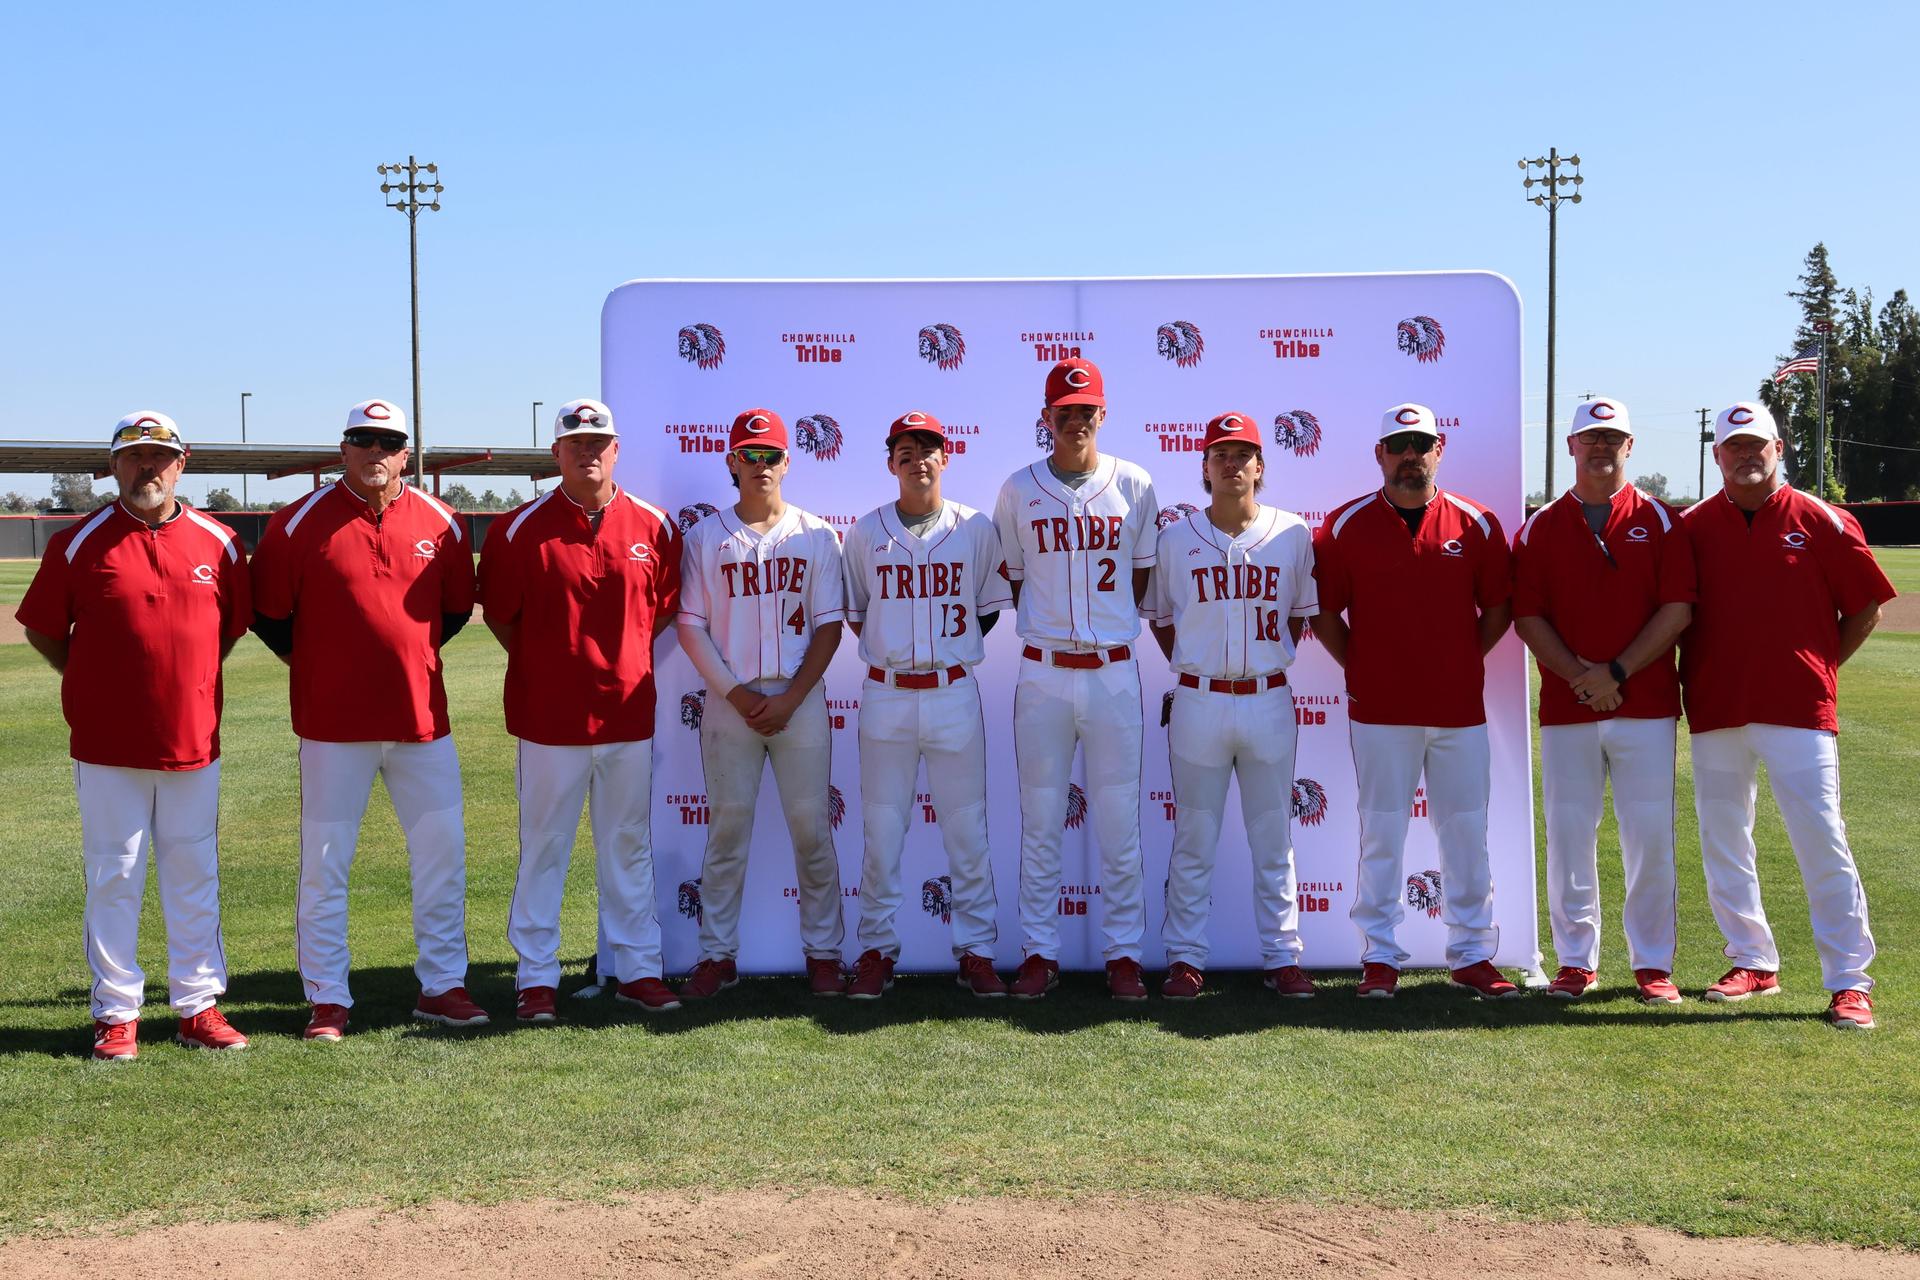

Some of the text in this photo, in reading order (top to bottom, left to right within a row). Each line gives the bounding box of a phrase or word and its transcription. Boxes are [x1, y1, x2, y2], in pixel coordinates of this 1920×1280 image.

[782, 333, 856, 343] CHOWCHILLA
[1020, 332, 1094, 342] CHOWCHILLA
[1260, 328, 1334, 338] CHOWCHILLA
[795, 344, 842, 362] Tribe
[1034, 343, 1081, 361] Tribe
[1273, 340, 1320, 358] Tribe
[1064, 368, 1090, 388] C
[363, 402, 391, 420] C
[901, 411, 927, 426] C
[1395, 407, 1421, 425] C
[1589, 402, 1616, 420] C
[1727, 407, 1754, 425] C
[665, 424, 731, 434] CHOWCHILL
[745, 415, 770, 434] C
[940, 425, 980, 435] CHILLA
[1145, 423, 1209, 433] CHOWCHIL
[1218, 415, 1244, 432] C
[678, 435, 726, 453] Tribe
[1031, 515, 1123, 554] TRIBE
[720, 557, 808, 598] TRIBE
[876, 562, 963, 599] TRIBE
[1097, 557, 1117, 592] 2
[1191, 564, 1280, 603] TRIBE
[941, 603, 967, 638] 13
[1254, 606, 1281, 642] 18
[1293, 695, 1340, 705] CHILLA
[1295, 707, 1326, 726] ibe
[666, 794, 707, 804] CHOWC
[1061, 885, 1101, 895] CHILLA
[1297, 882, 1343, 892] CHILLA
[1057, 897, 1087, 916] ibe
[1298, 894, 1329, 912] ibe
